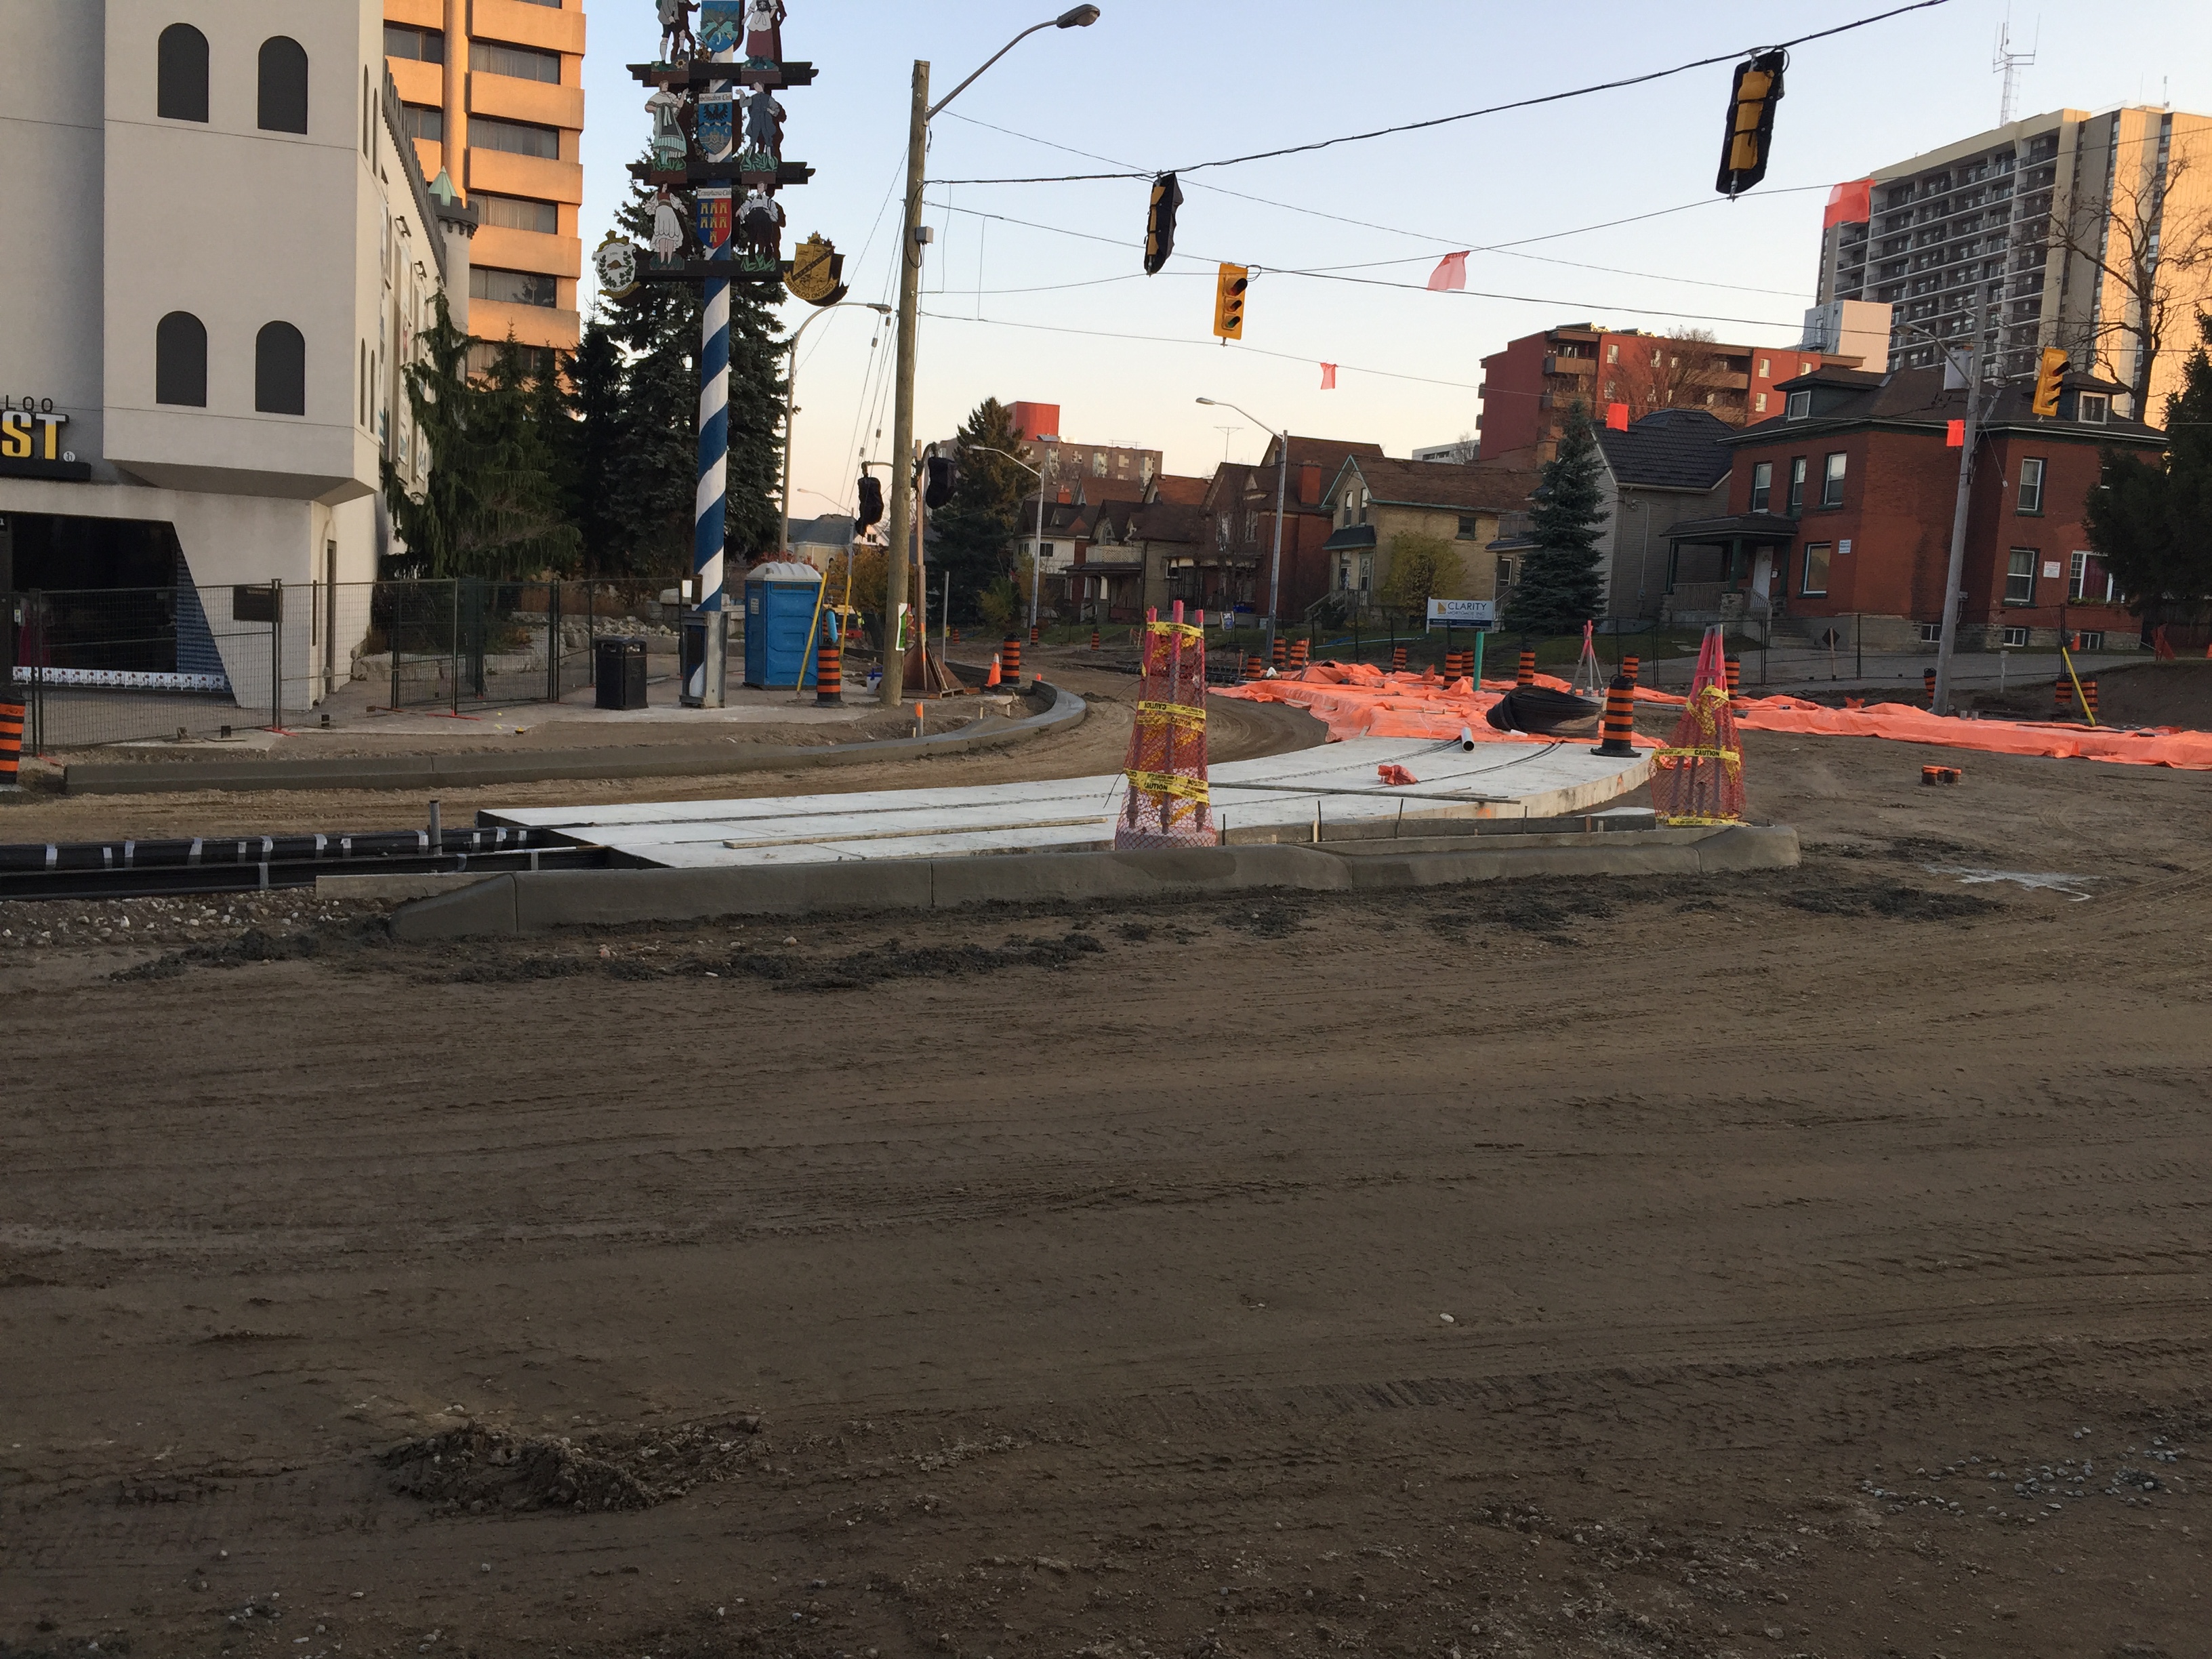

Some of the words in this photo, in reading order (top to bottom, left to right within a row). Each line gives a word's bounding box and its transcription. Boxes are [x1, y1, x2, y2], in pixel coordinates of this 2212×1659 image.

[785, 277, 810, 299] WATERLOO
[811, 283, 834, 299] ONTARIO
[1448, 601, 1487, 611] CLARITY
[1143, 701, 1167, 710] CAUTION
